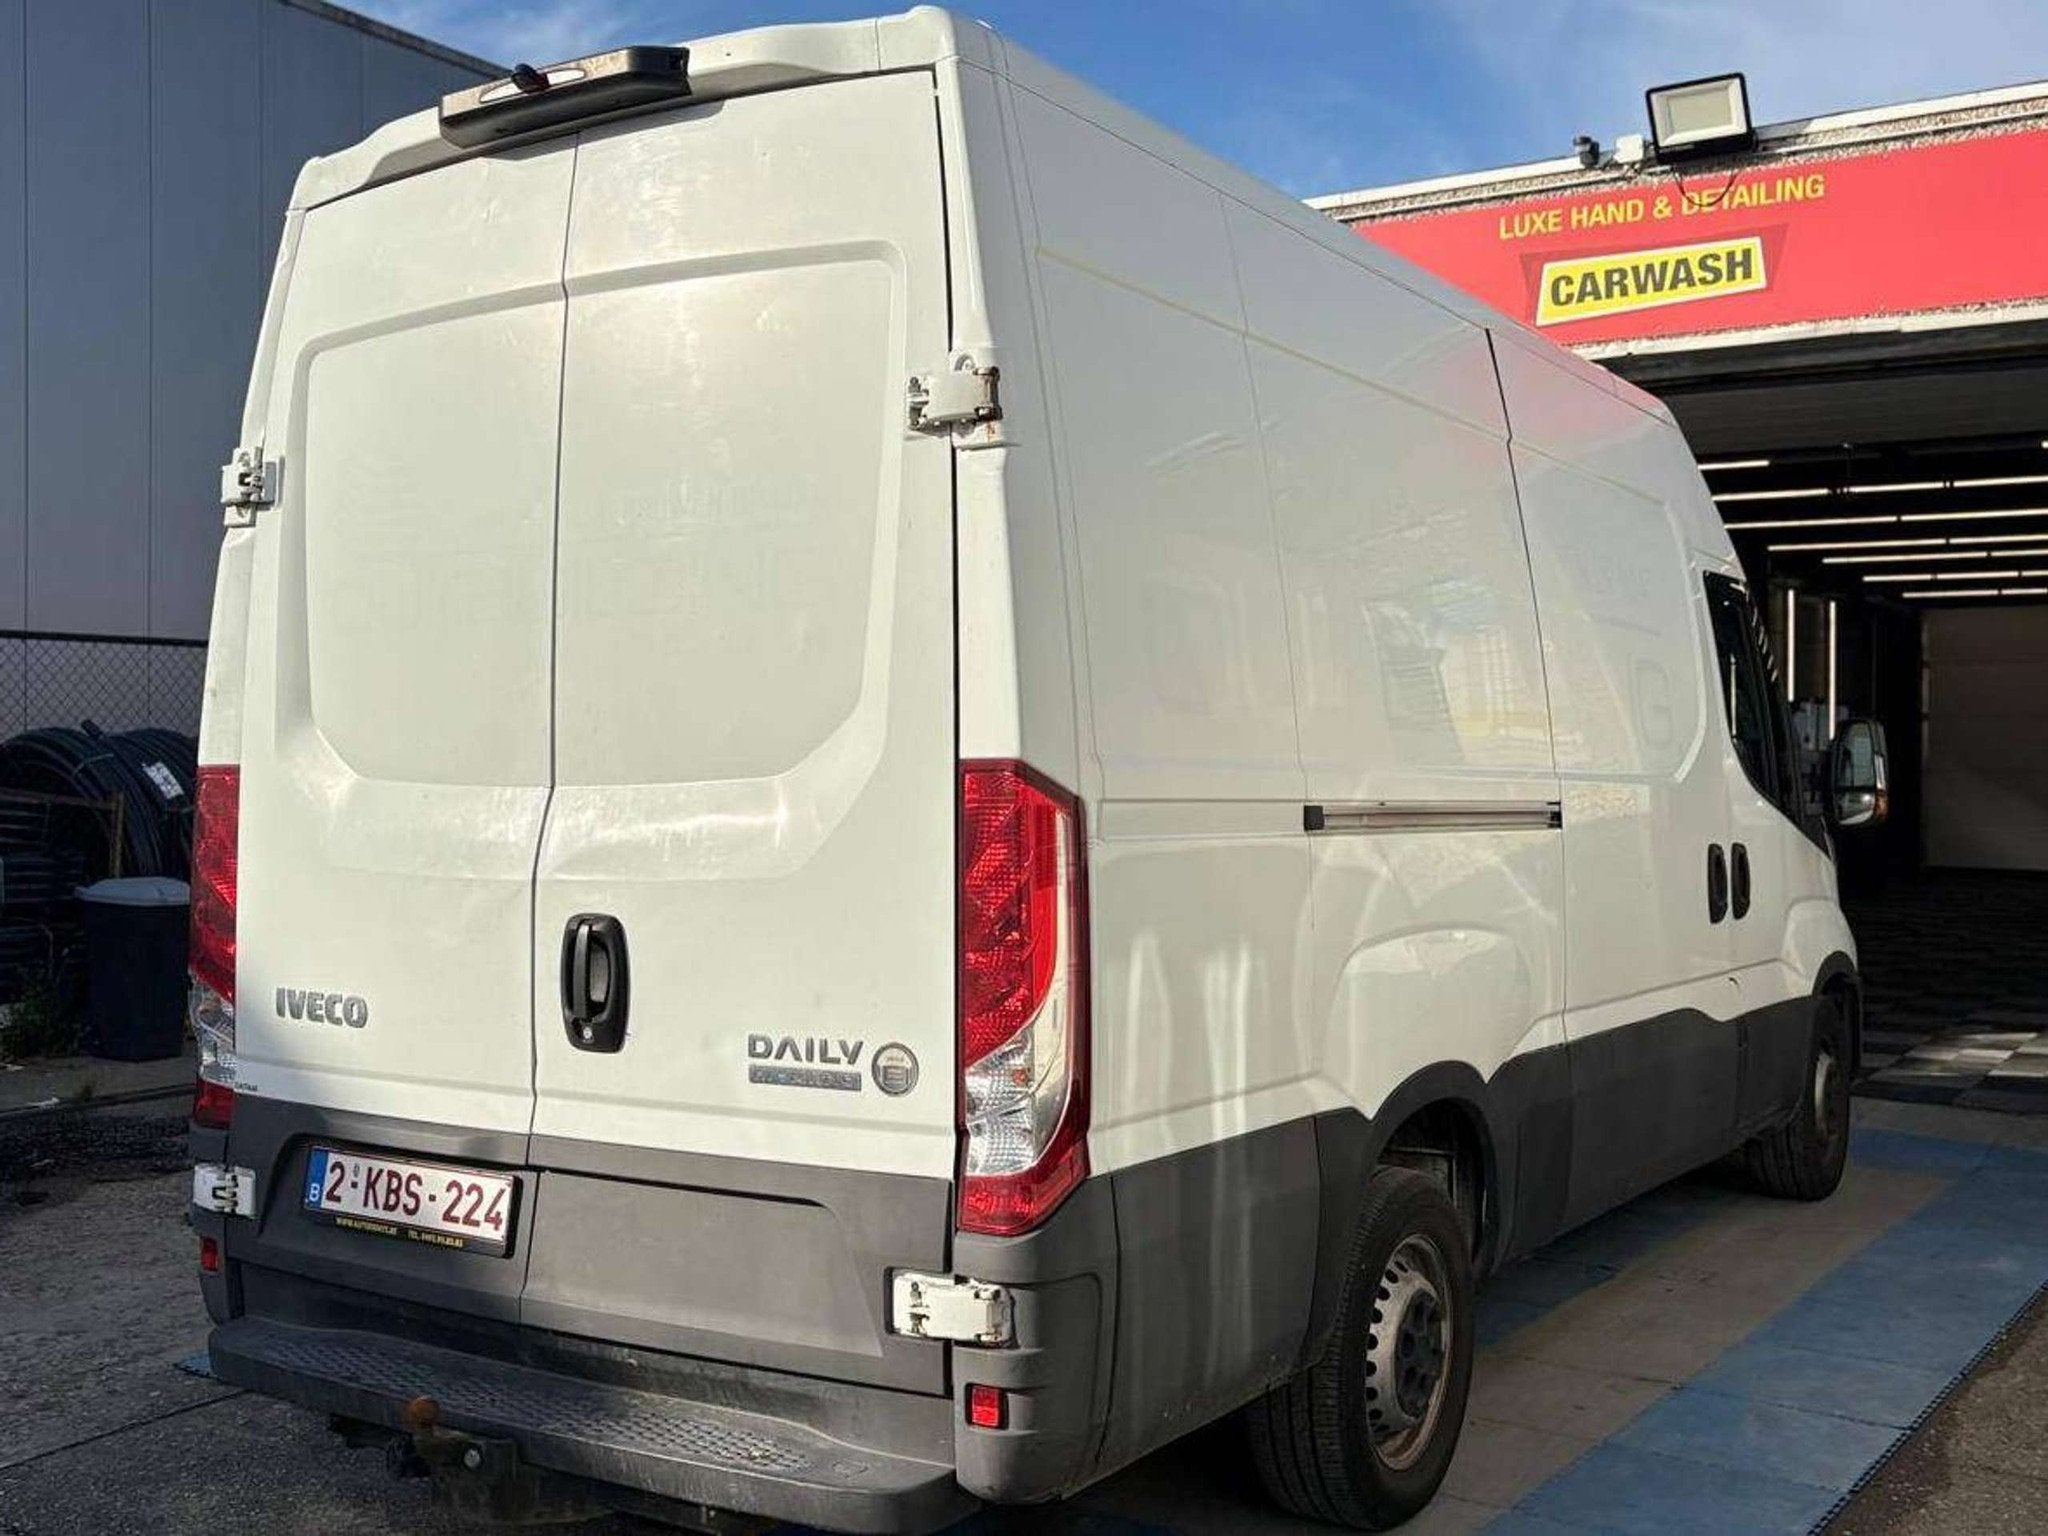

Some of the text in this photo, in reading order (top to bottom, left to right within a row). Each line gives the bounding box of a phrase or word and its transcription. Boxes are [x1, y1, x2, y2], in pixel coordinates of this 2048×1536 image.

[1499, 173, 1825, 240] LUXE HAND & DETAILING
[1550, 247, 1754, 307] CARWASH
[275, 987, 369, 1029] IVECO
[748, 1033, 864, 1065] DAILY
